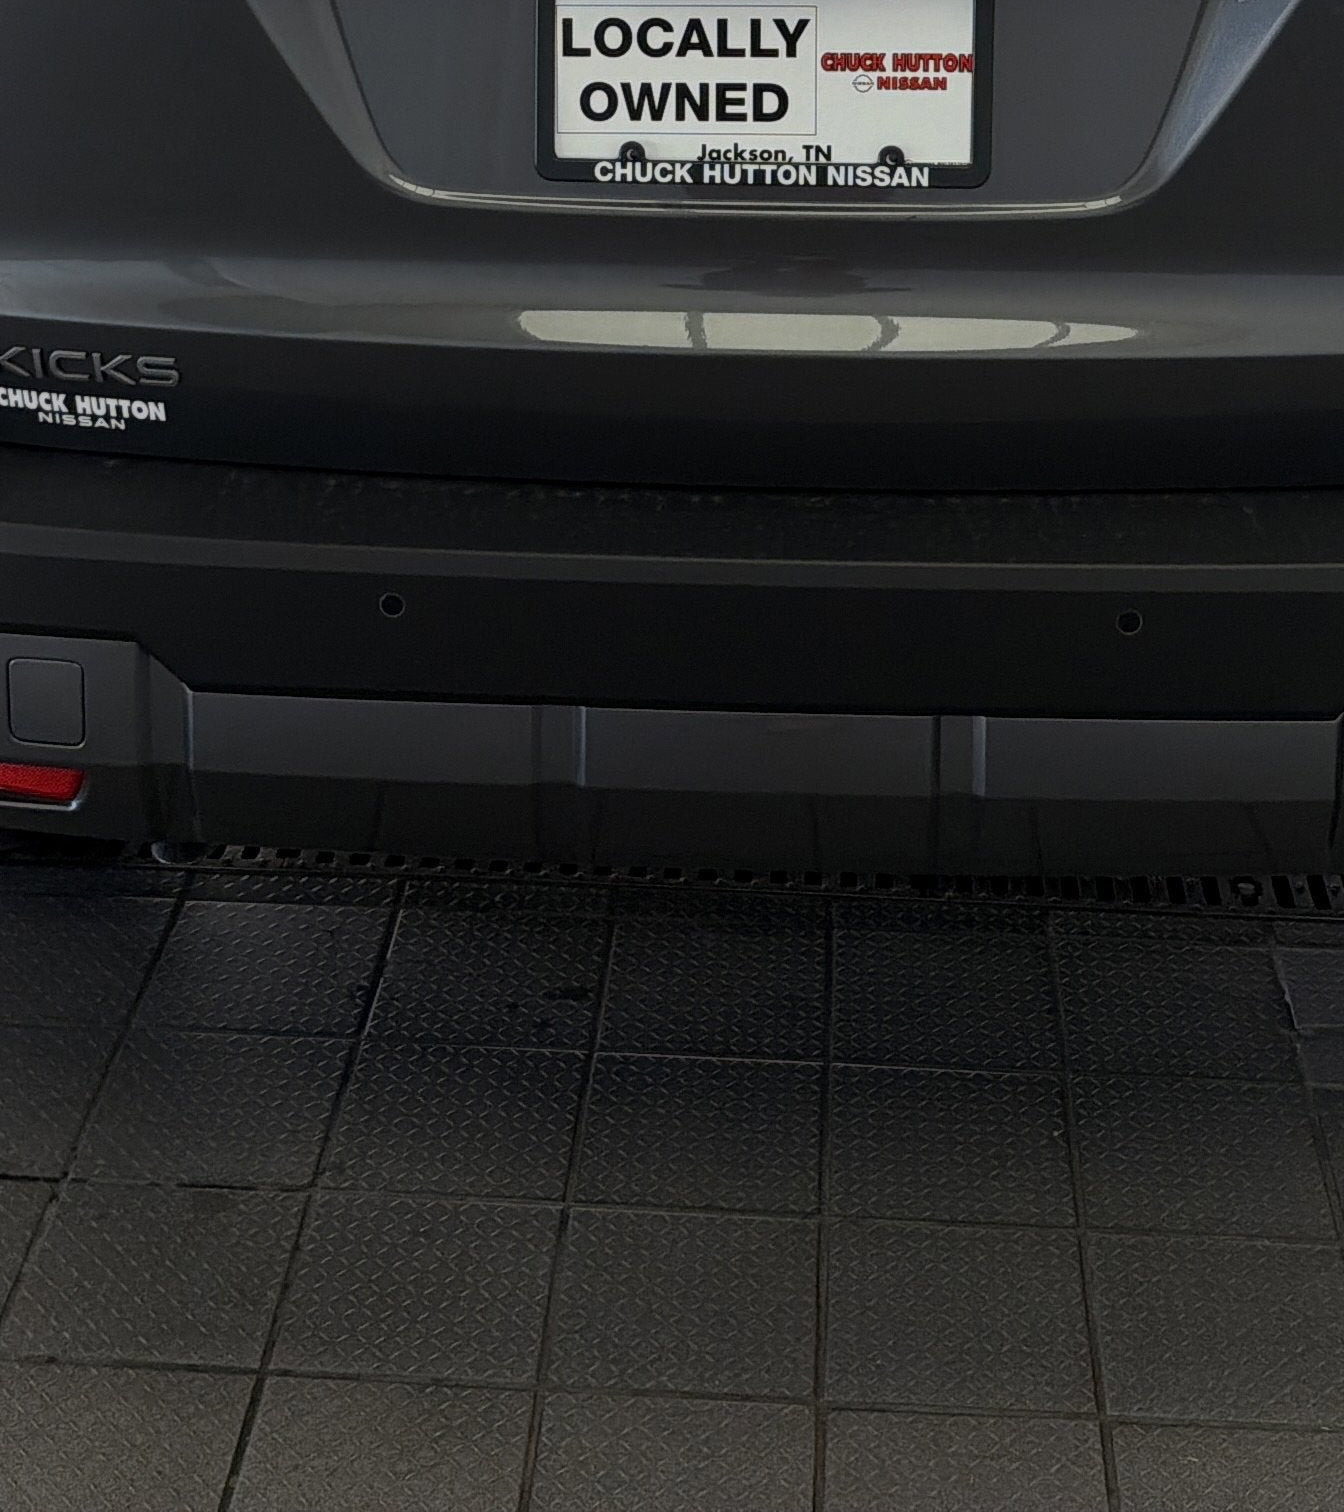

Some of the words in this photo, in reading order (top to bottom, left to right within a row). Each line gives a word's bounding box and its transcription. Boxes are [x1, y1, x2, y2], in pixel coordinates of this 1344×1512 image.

[562, 17, 811, 59] LOCALLY
[821, 52, 886, 72] CHUCK
[892, 53, 973, 73] HUTTON
[877, 76, 947, 91] NISSAN
[579, 81, 789, 123] OWNED
[696, 144, 794, 163] Jackson,
[802, 145, 832, 162] TN
[594, 162, 693, 184] CHUCK
[703, 164, 819, 186] HUTTON
[827, 165, 930, 187] NISSAN
[74, 395, 167, 422] HUTTON
[38, 411, 126, 431] NISSAN
